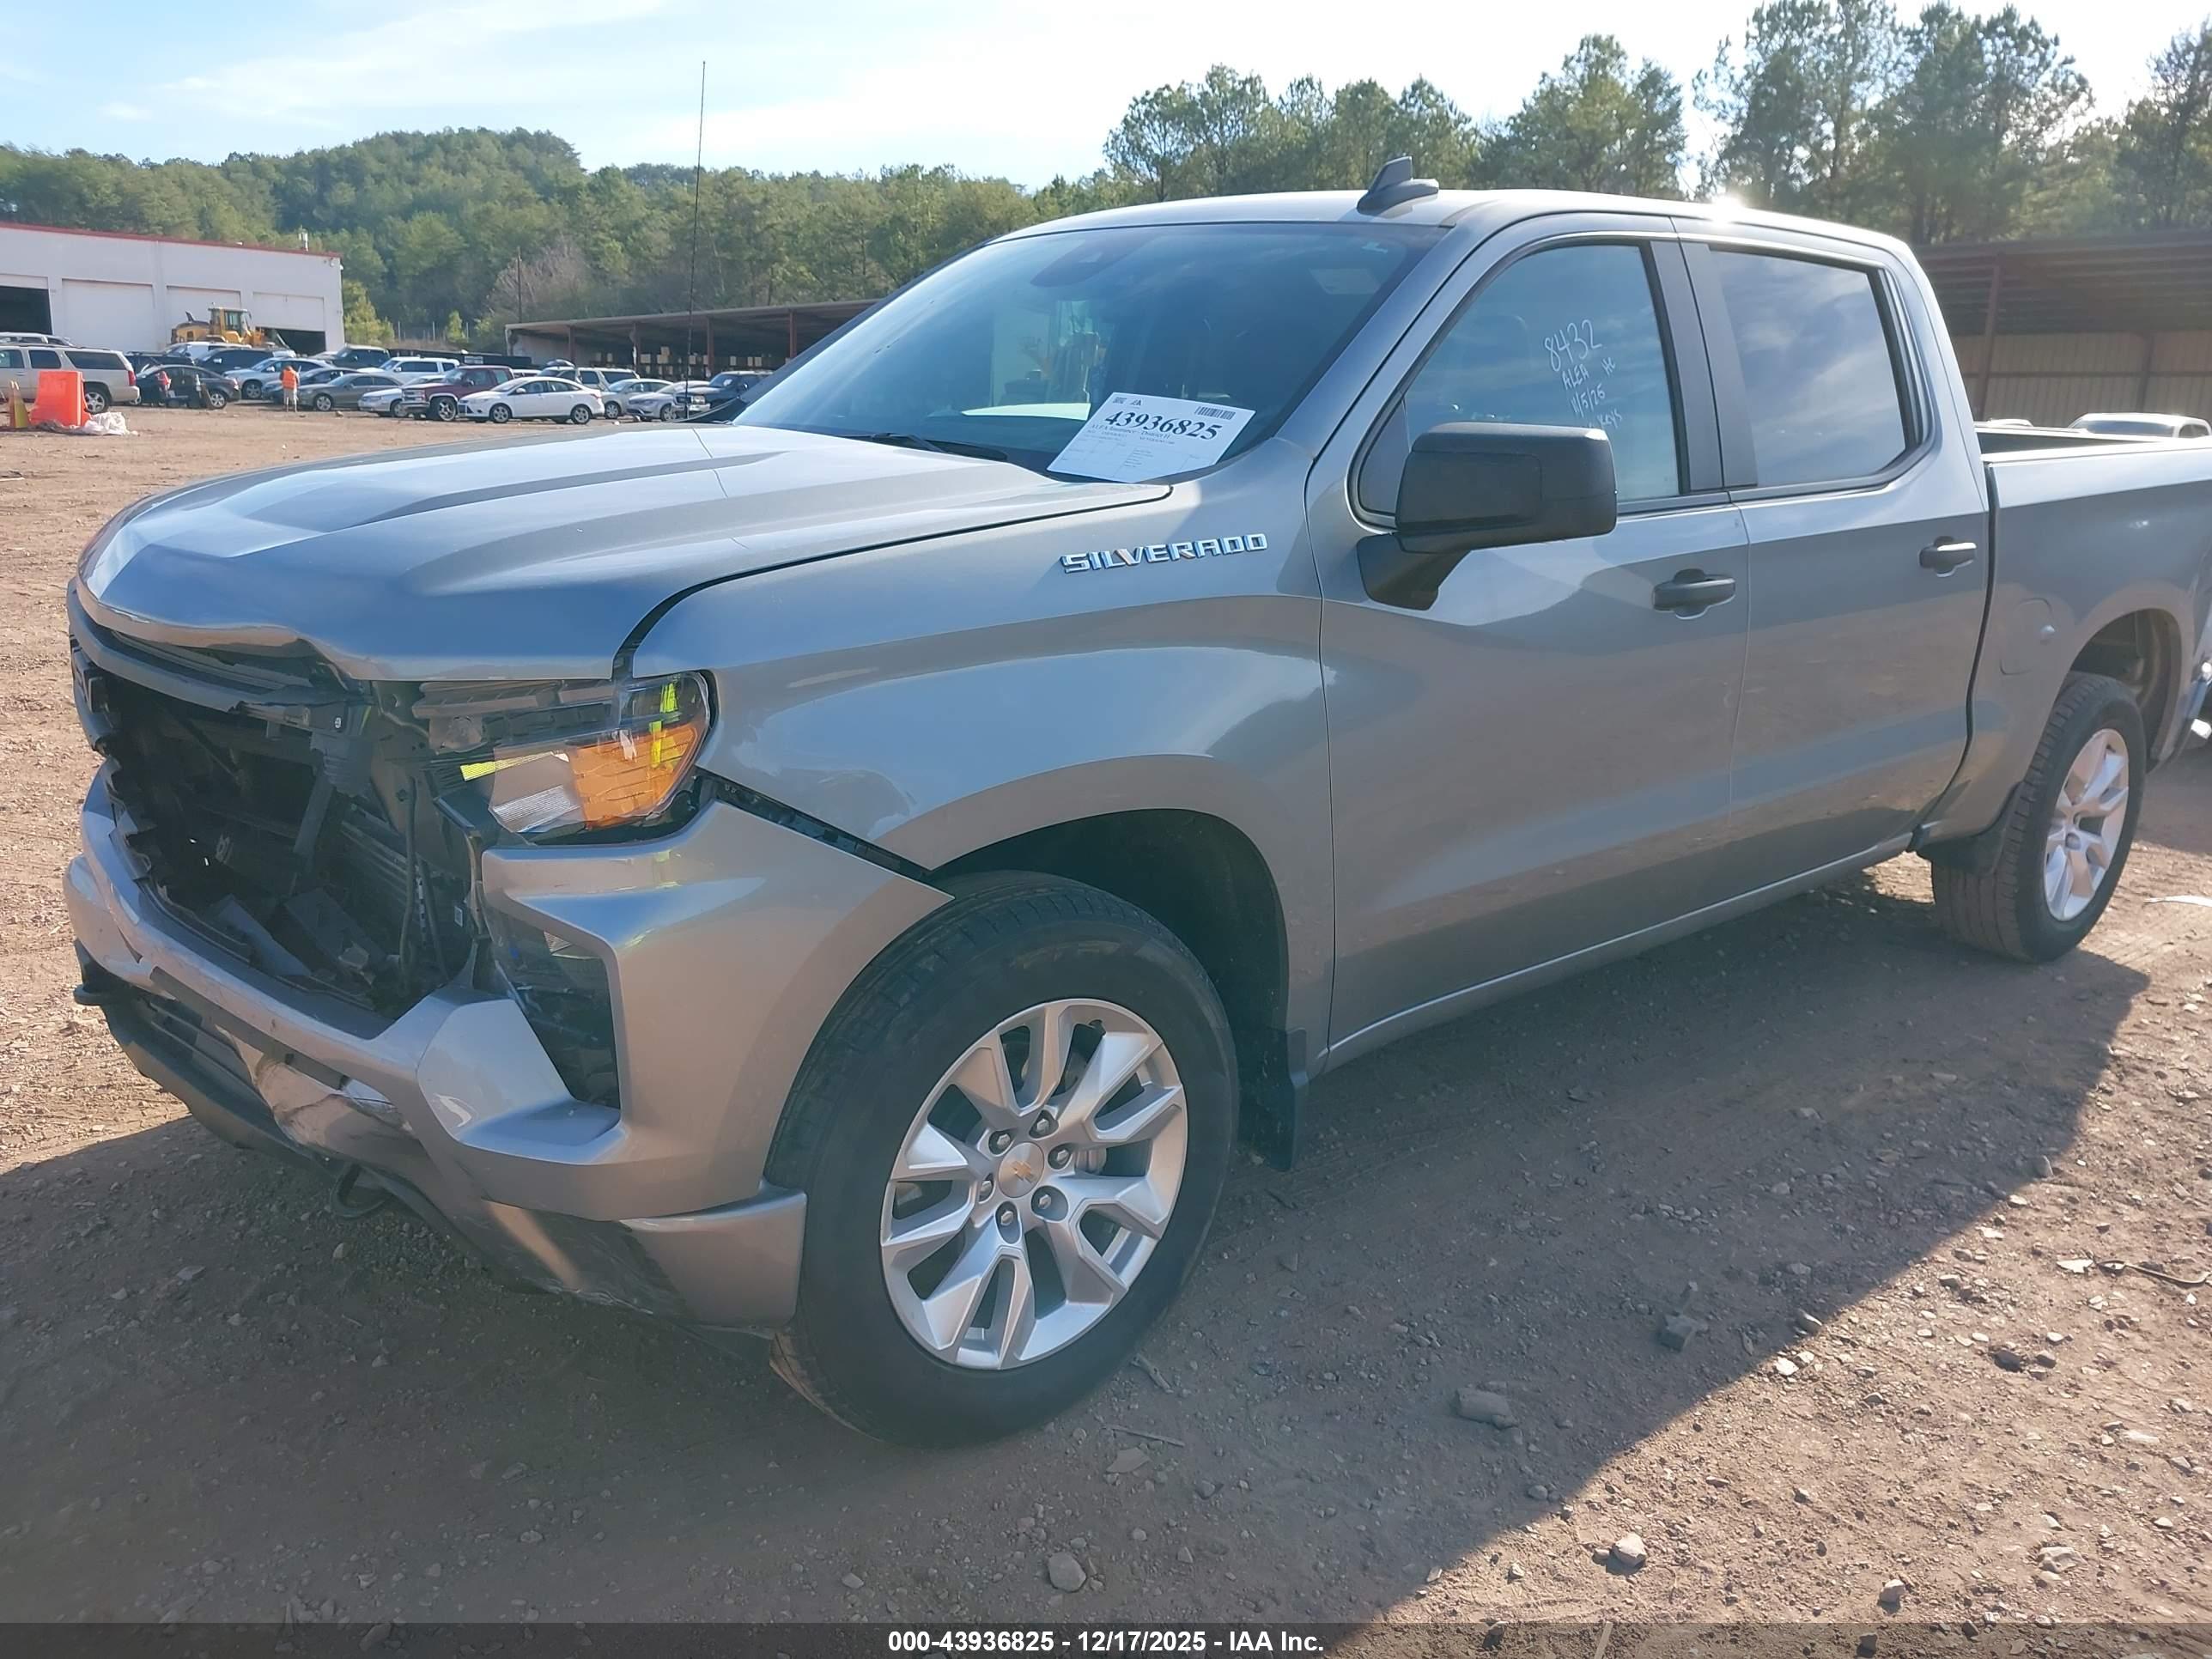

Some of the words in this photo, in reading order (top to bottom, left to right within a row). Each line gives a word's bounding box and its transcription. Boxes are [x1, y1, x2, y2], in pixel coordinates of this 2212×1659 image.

[1544, 319, 1603, 372] 8432
[1104, 410, 1224, 441] 43936825
[1061, 533, 1268, 574] SILVERADO
